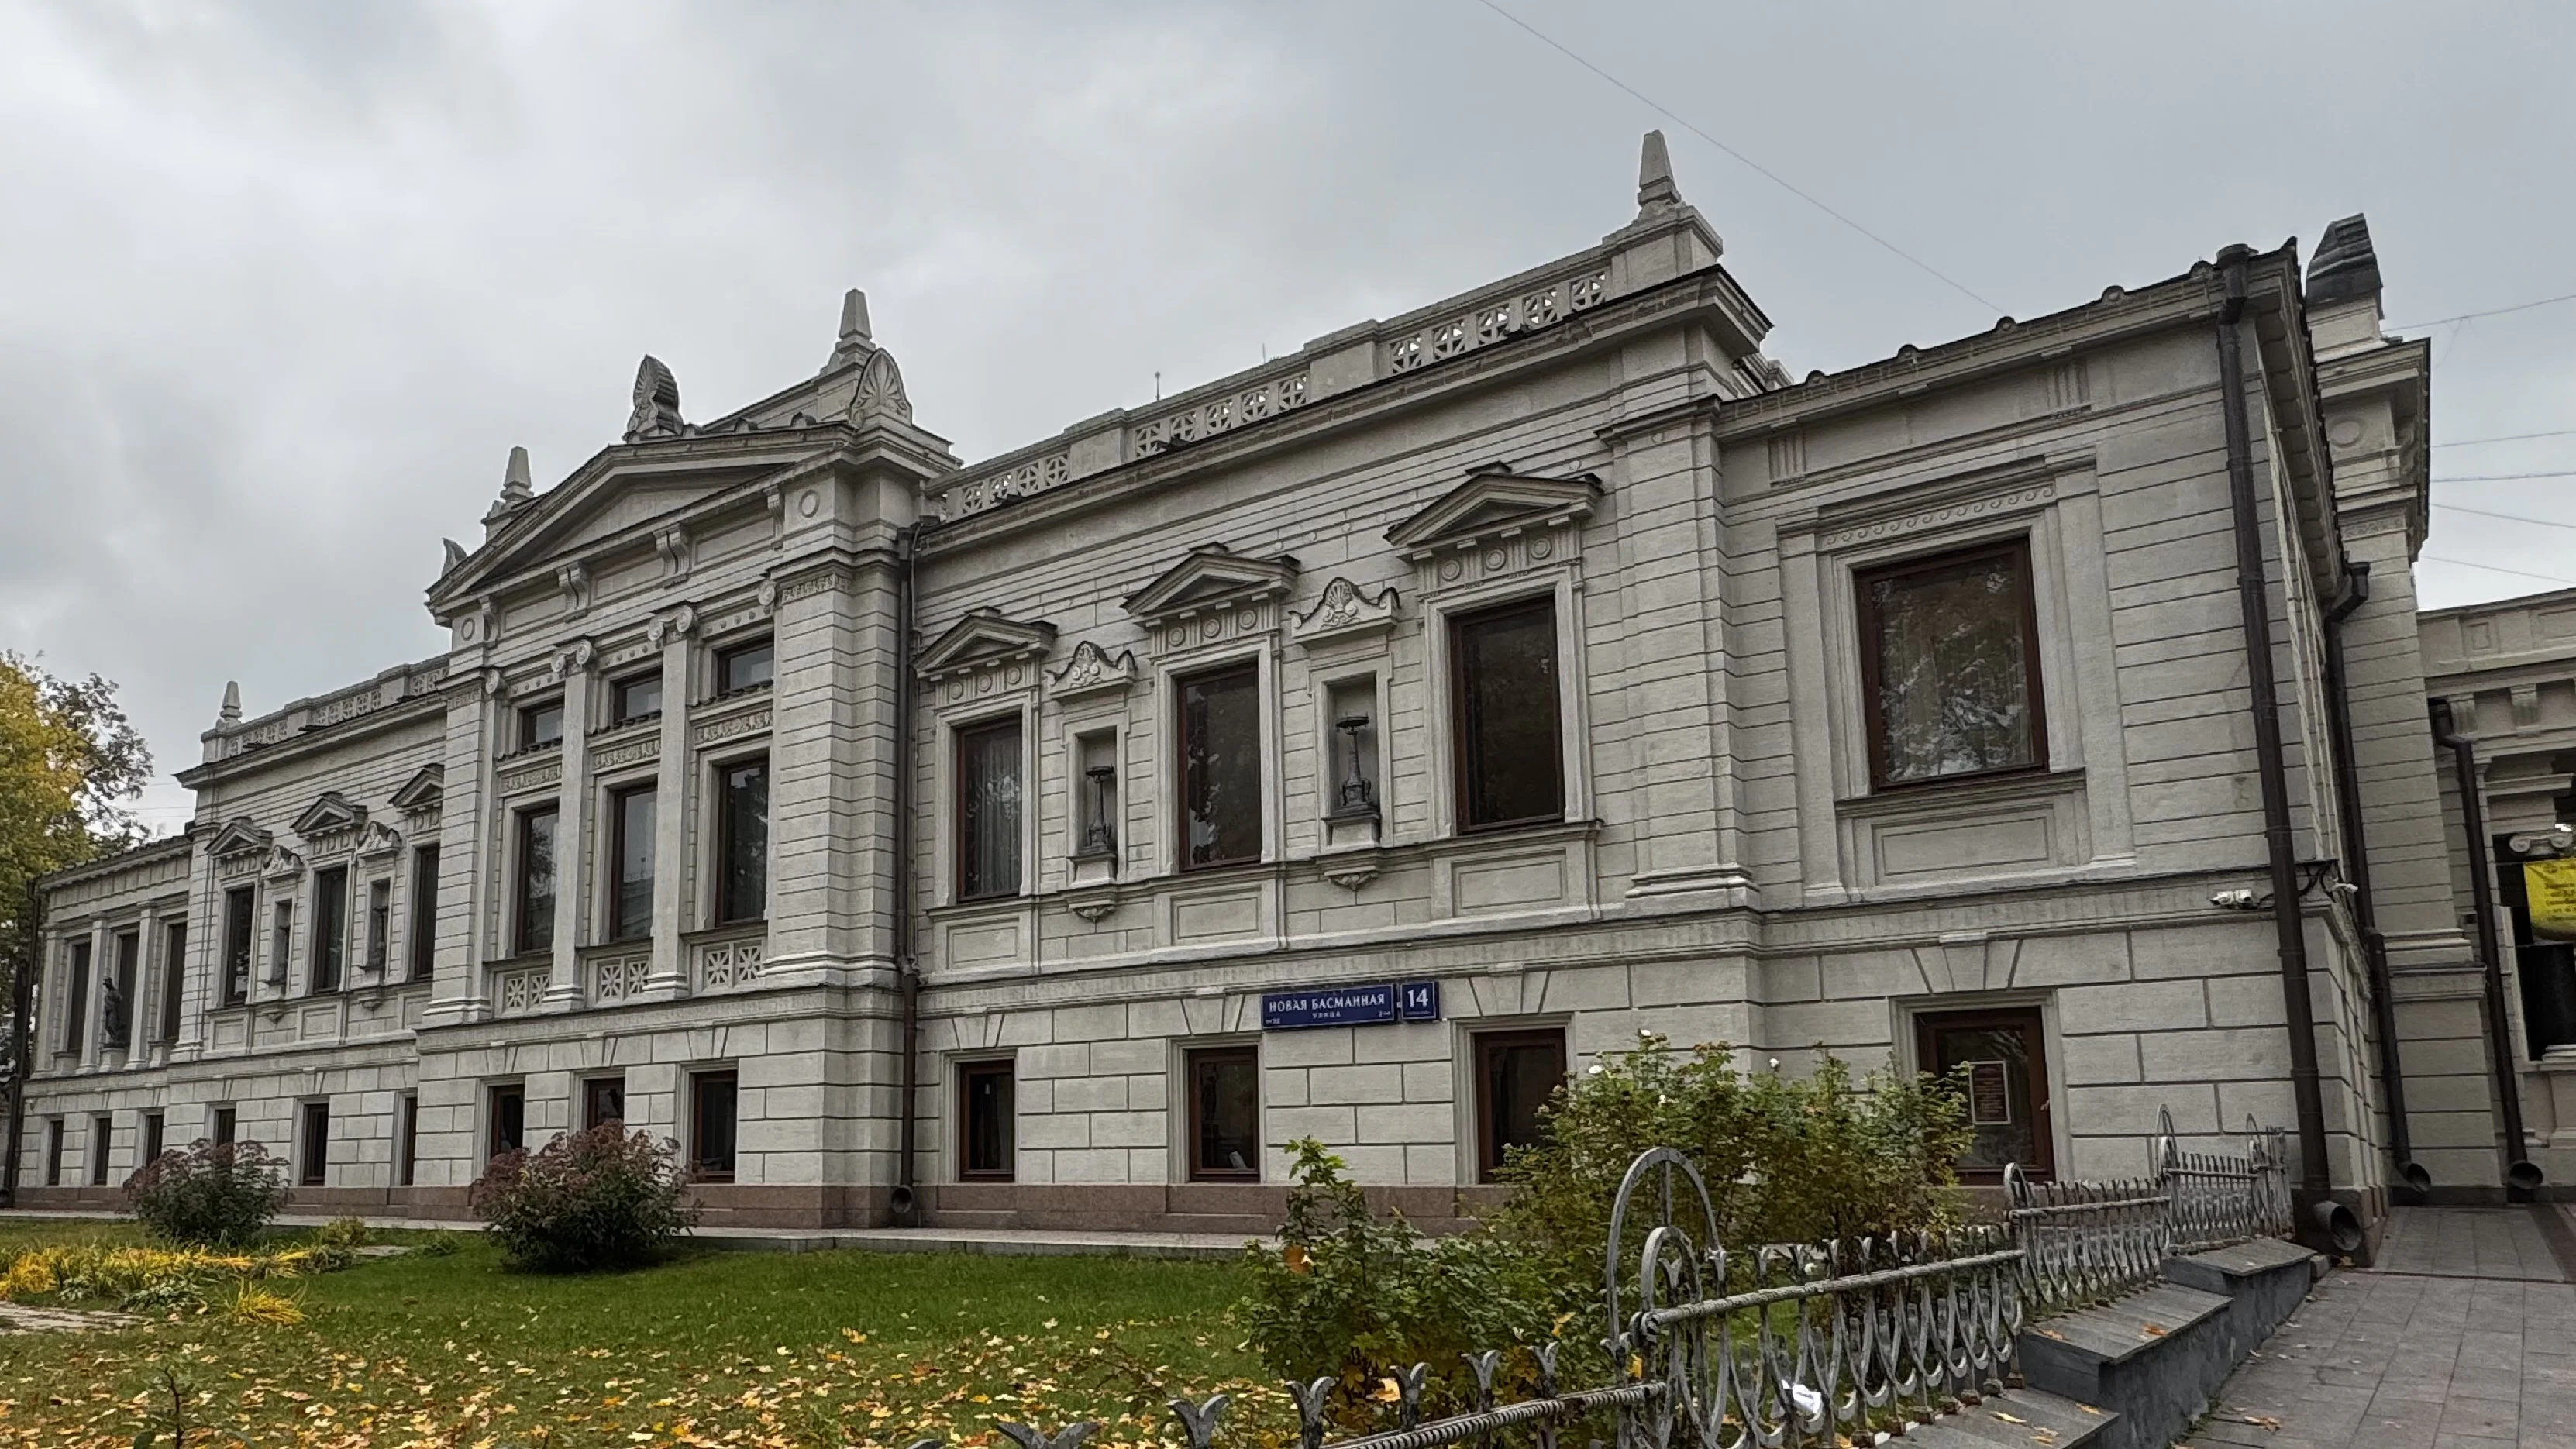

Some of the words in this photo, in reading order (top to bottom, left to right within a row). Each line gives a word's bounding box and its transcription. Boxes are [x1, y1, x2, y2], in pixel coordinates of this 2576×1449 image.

[1269, 1000, 1307, 1012] НОВАЯ
[1312, 993, 1385, 1010] БАСМАННАЯ
[1407, 988, 1428, 1007] 14
